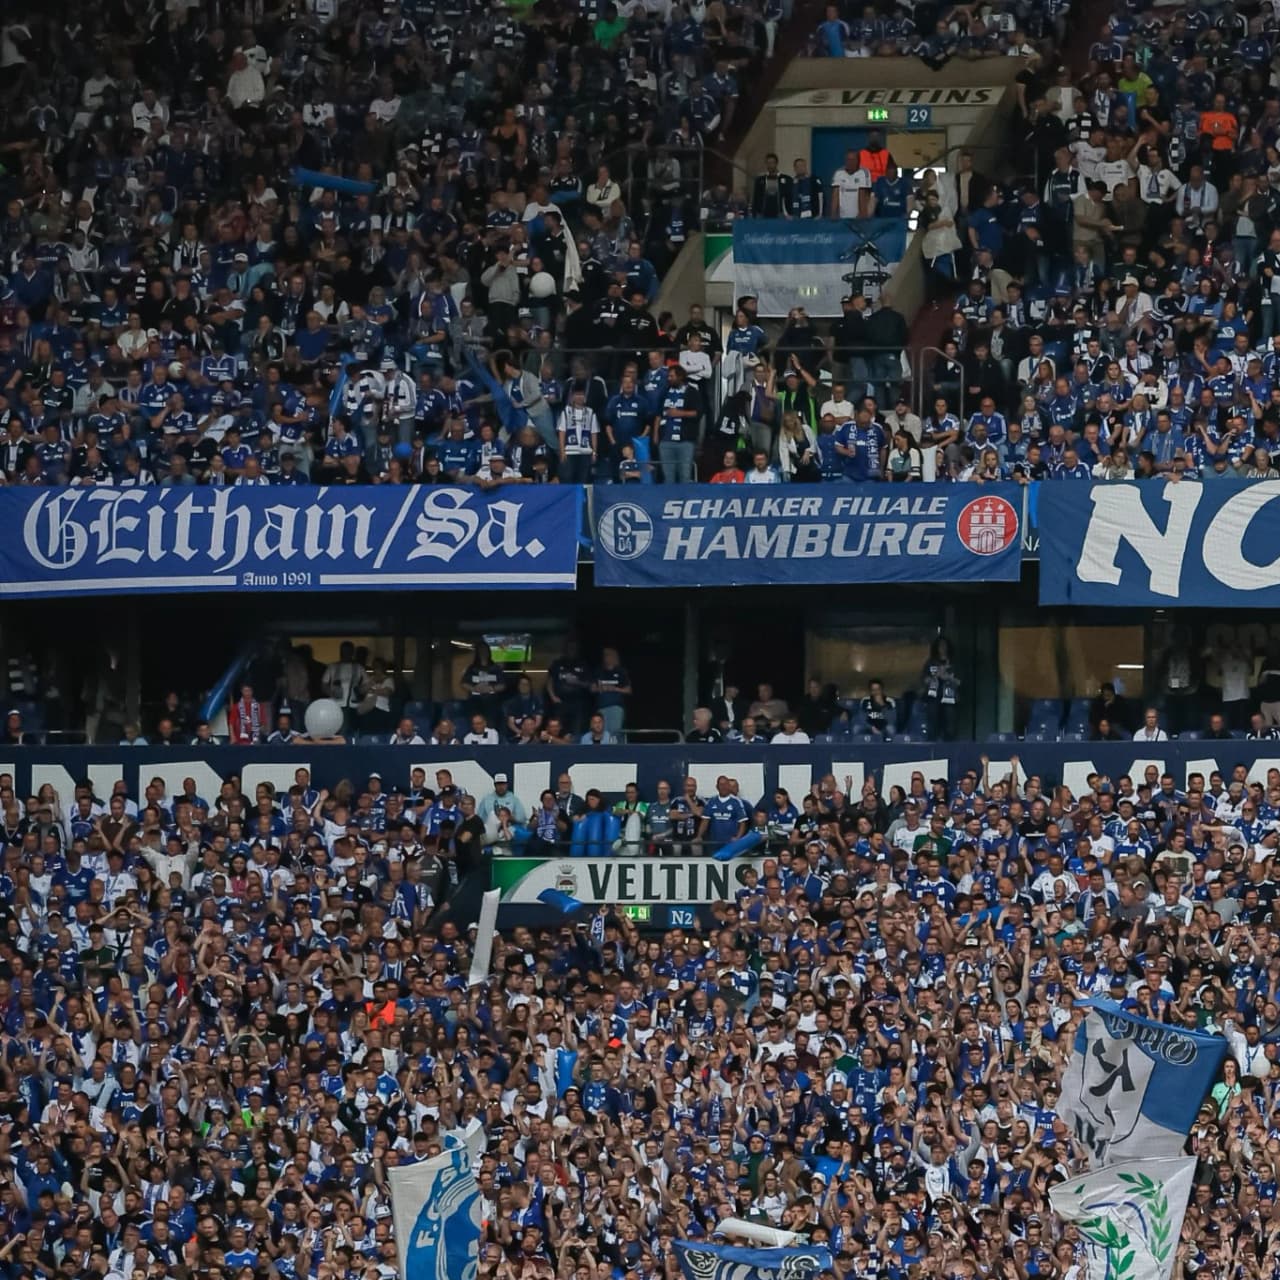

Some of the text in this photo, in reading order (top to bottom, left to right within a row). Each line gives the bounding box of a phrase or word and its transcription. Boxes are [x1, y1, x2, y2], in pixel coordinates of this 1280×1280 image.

[841, 88, 993, 104] VELTINS
[910, 109, 928, 123] 29
[662, 496, 949, 519] SCHALKER FILIALE
[662, 521, 947, 560] HAMBURG
[242, 571, 312, 587] Anno 1991
[671, 909, 692, 925] N2
